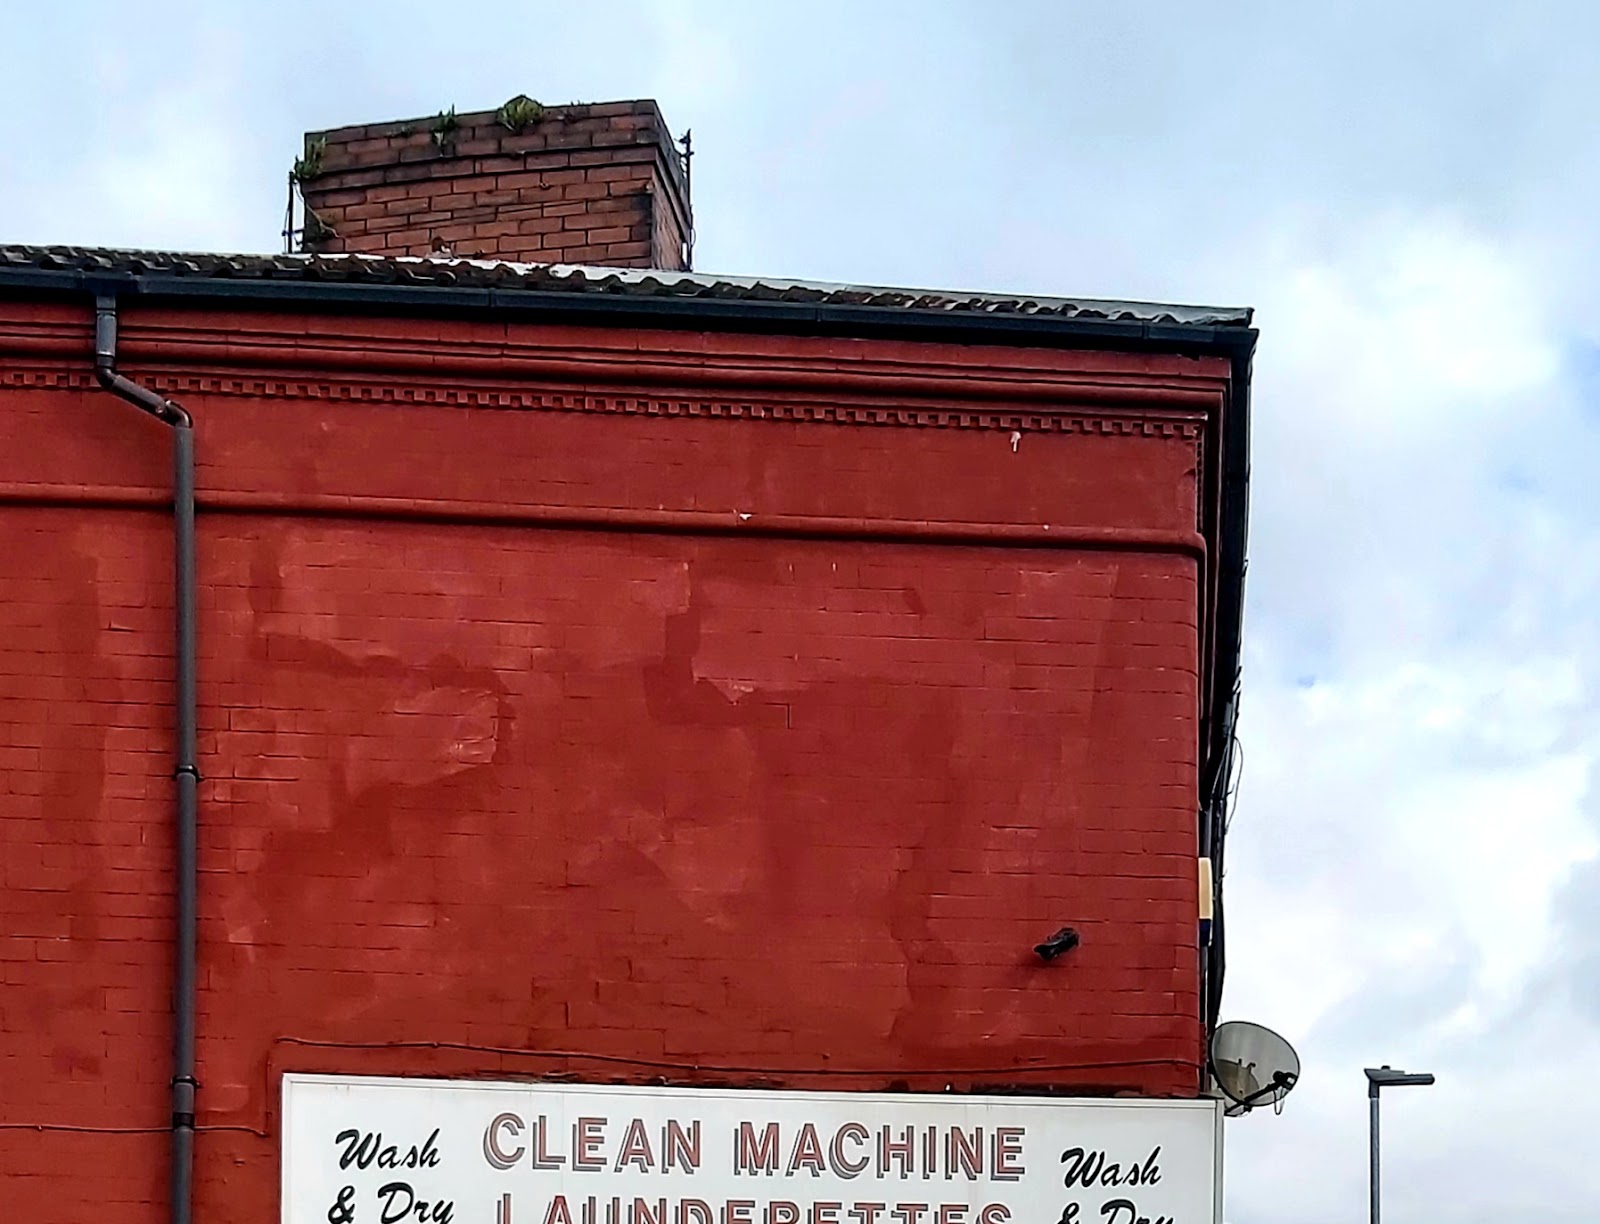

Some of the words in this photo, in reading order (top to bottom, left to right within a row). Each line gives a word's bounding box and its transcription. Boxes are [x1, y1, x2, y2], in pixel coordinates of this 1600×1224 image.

[335, 1128, 441, 1171] Wash
[483, 1112, 702, 1175] CLEAN
[734, 1121, 1026, 1182] MACHINE
[1060, 1145, 1162, 1188] Wash
